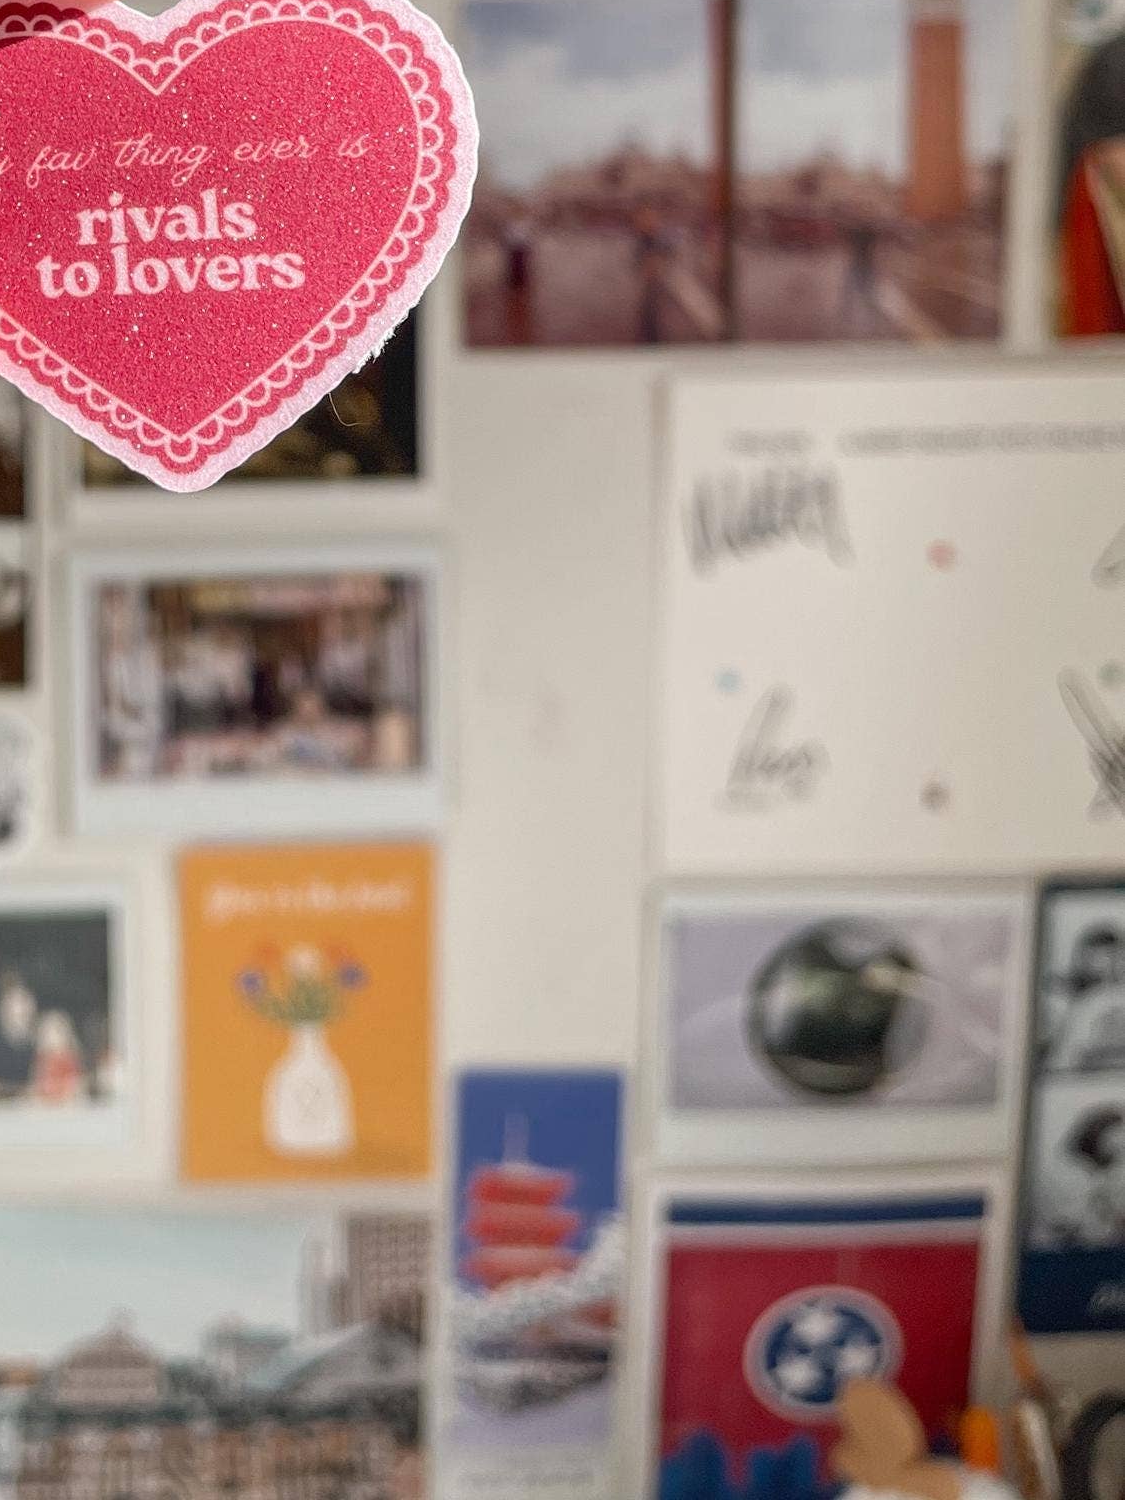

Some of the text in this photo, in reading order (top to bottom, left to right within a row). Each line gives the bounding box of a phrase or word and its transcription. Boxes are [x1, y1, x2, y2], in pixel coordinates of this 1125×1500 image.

[27, 145, 96, 188] fav
[113, 133, 213, 187] thing
[234, 135, 318, 162] ever
[337, 133, 374, 159] is
[76, 187, 257, 246] rivals
[36, 244, 306, 299] to lovers
